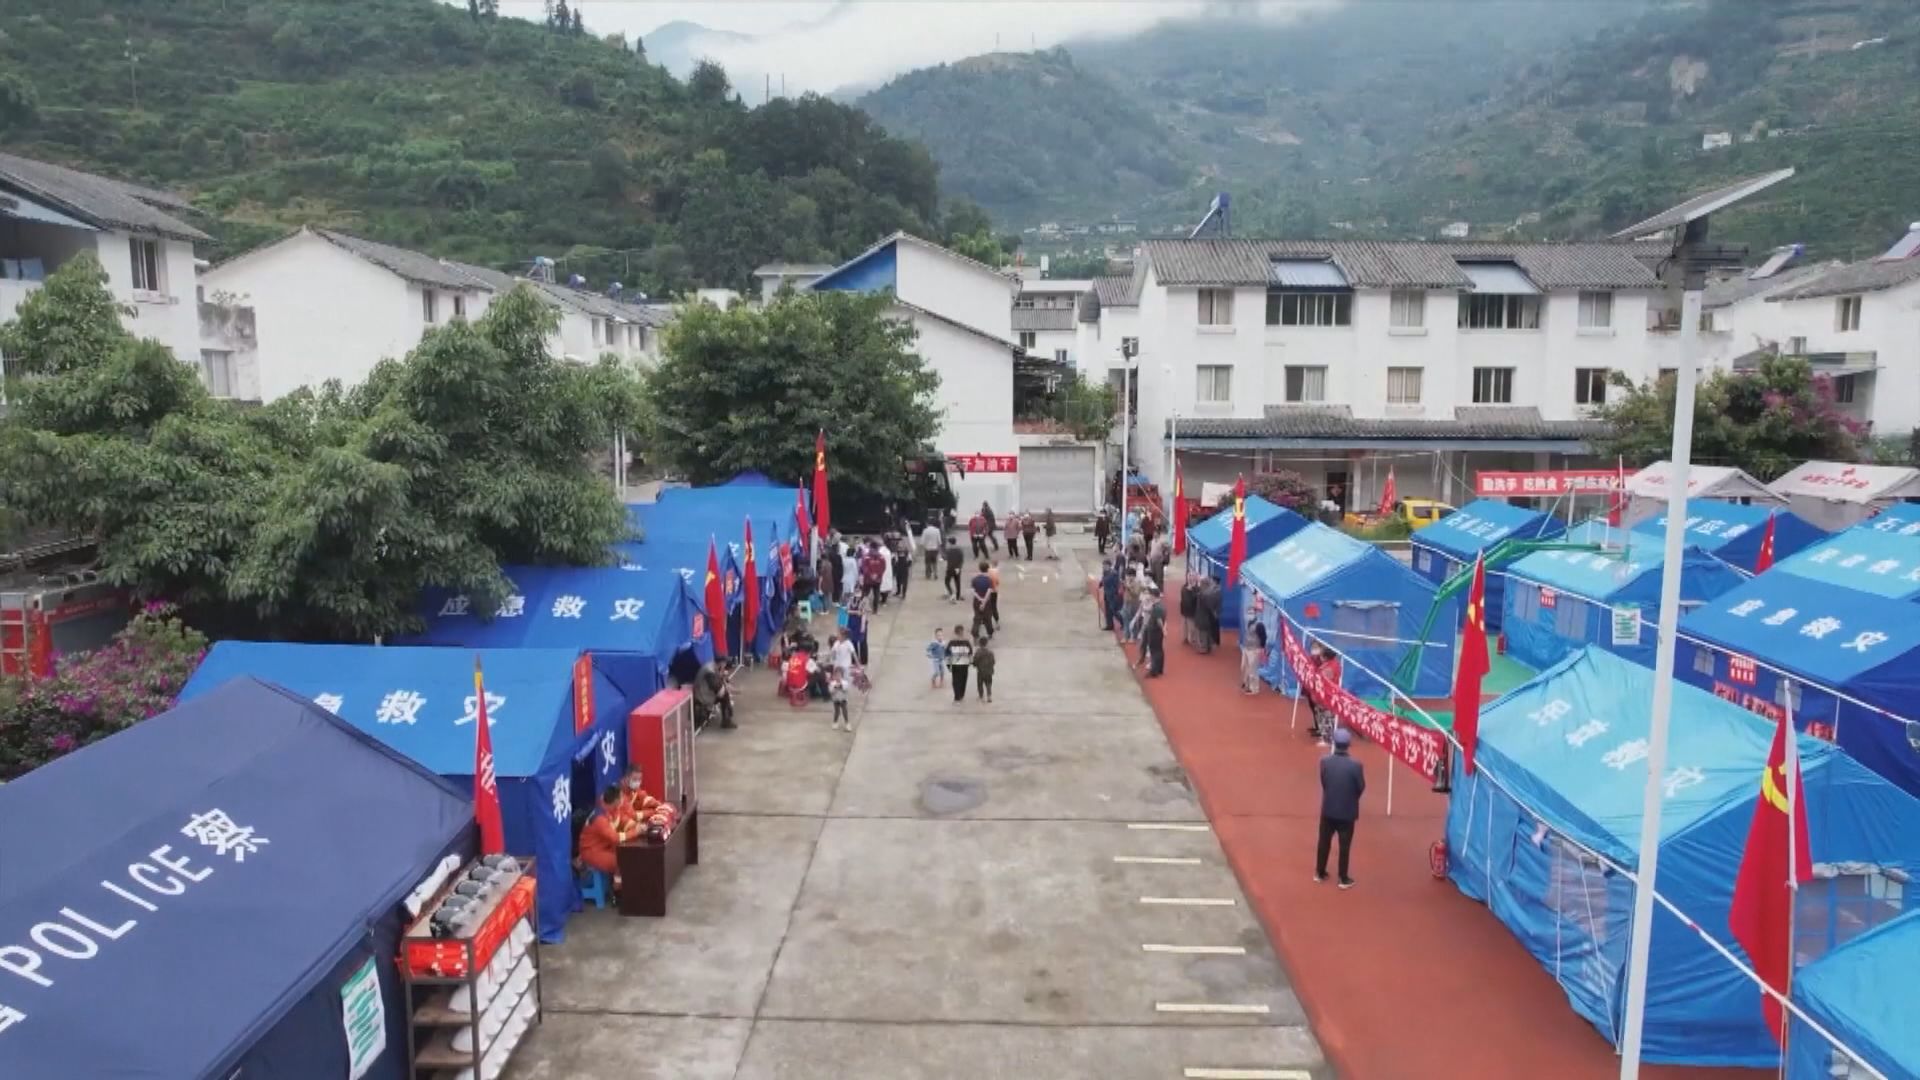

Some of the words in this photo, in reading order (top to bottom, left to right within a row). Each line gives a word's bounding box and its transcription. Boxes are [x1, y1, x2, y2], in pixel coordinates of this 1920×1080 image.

[948, 457, 1010, 471] 子加油干
[438, 594, 645, 621] 应急救灾
[0, 844, 214, 987] POLICE
[180, 808, 270, 863] 察
